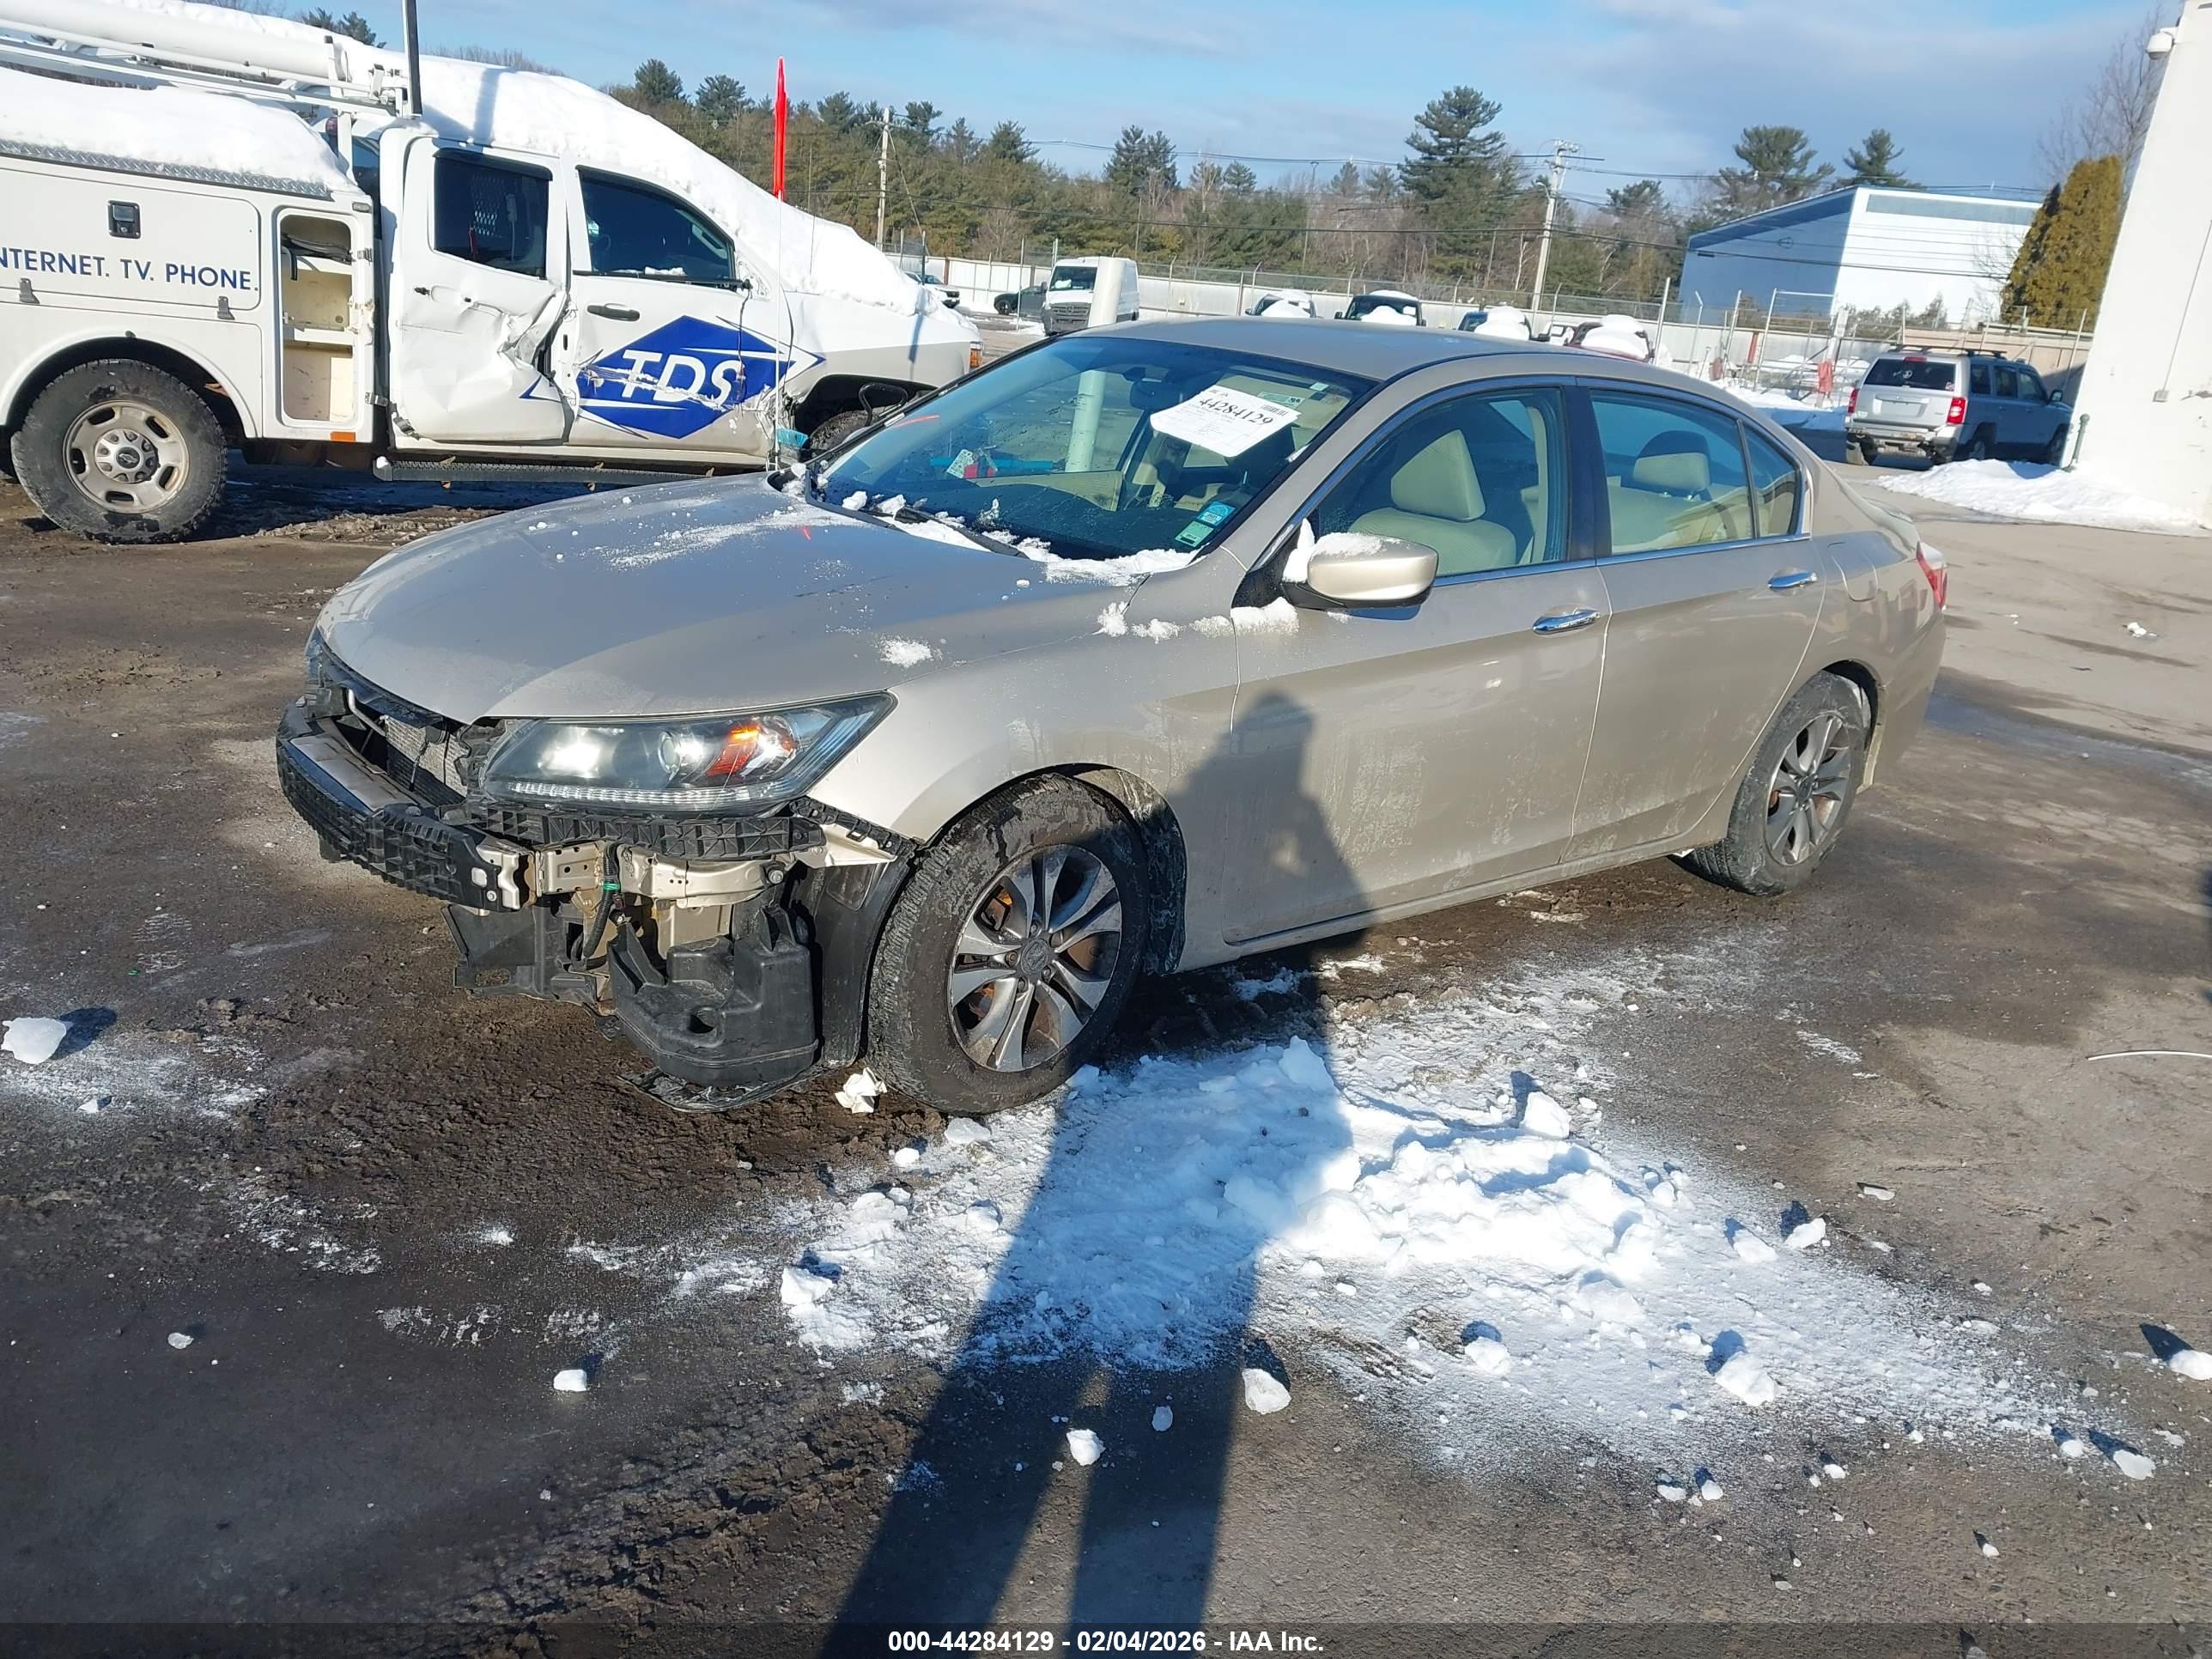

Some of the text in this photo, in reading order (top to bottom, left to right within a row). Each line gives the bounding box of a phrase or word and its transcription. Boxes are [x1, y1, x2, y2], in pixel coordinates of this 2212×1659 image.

[119, 258, 155, 282] TV.
[165, 263, 259, 292] PHONE.
[622, 349, 745, 408] TDS
[1200, 398, 1274, 426] 44284129
